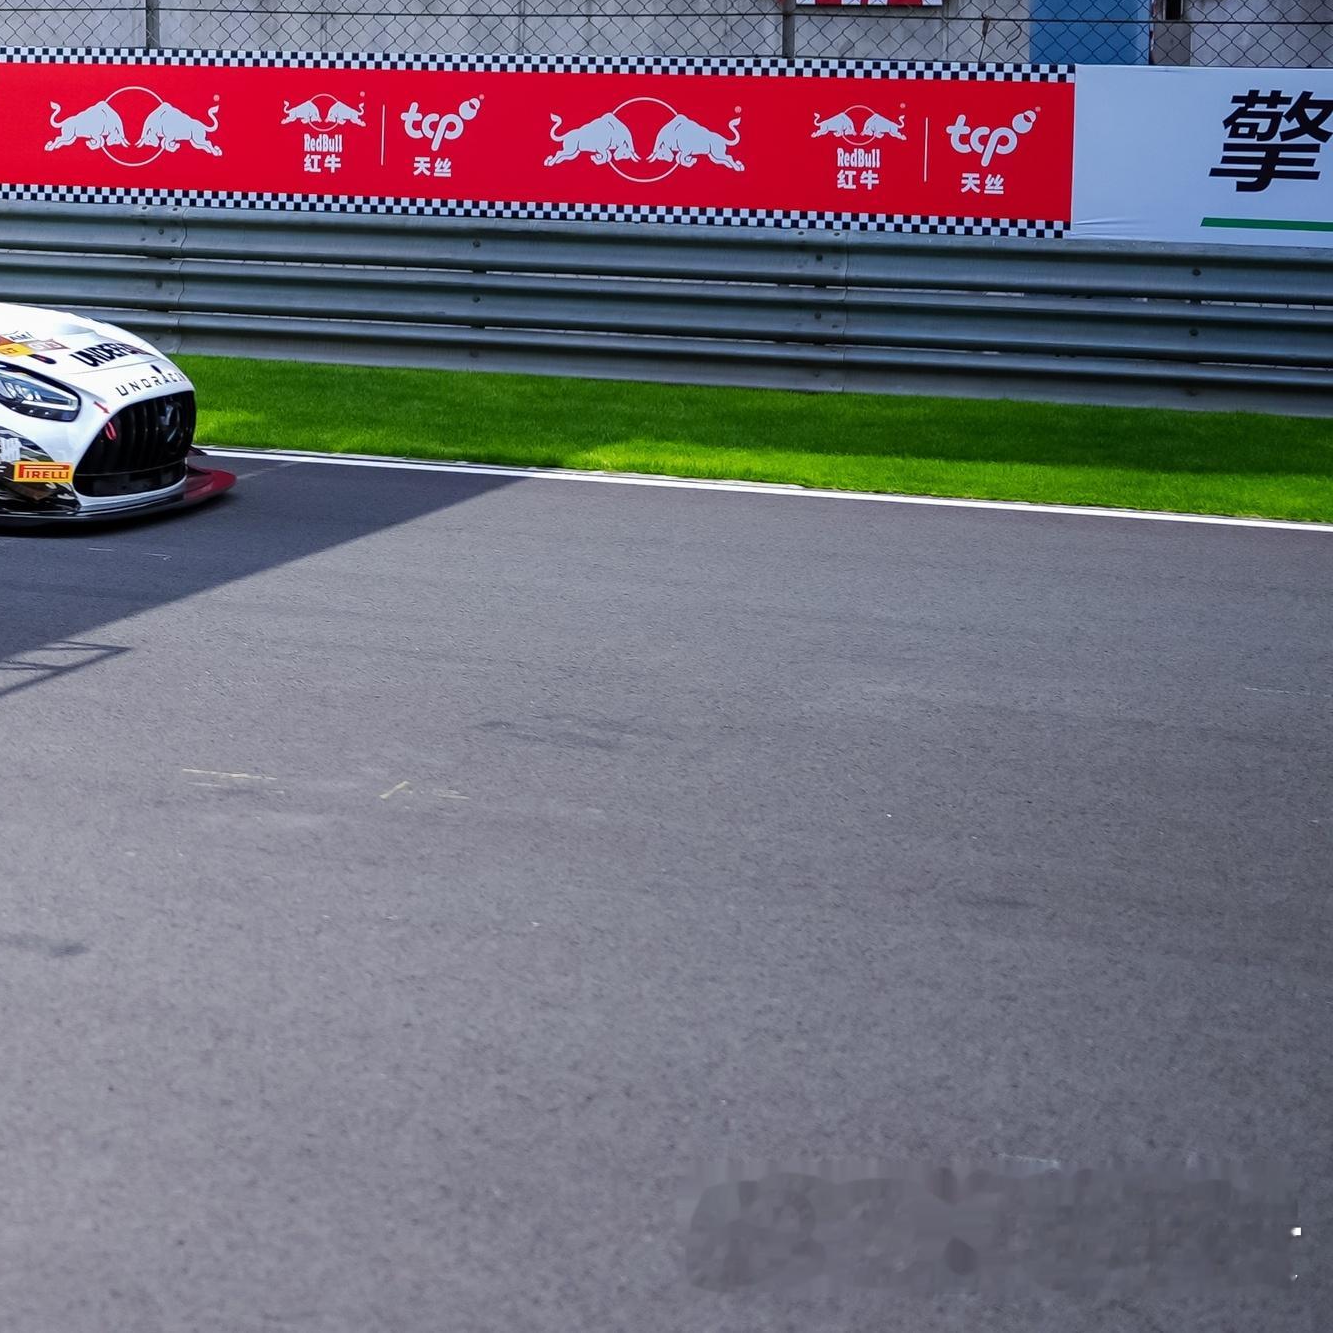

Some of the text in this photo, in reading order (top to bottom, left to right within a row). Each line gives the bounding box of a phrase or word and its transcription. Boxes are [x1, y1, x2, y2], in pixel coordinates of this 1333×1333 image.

[400, 101, 465, 151] tcp
[946, 113, 1018, 167] tcp
[1208, 89, 1333, 193] 擎
[304, 154, 342, 174] 红牛
[413, 157, 452, 178] 天丝
[837, 170, 880, 191] 红牛
[961, 172, 1005, 195] 天丝
[18, 464, 70, 479] PIRELLI
